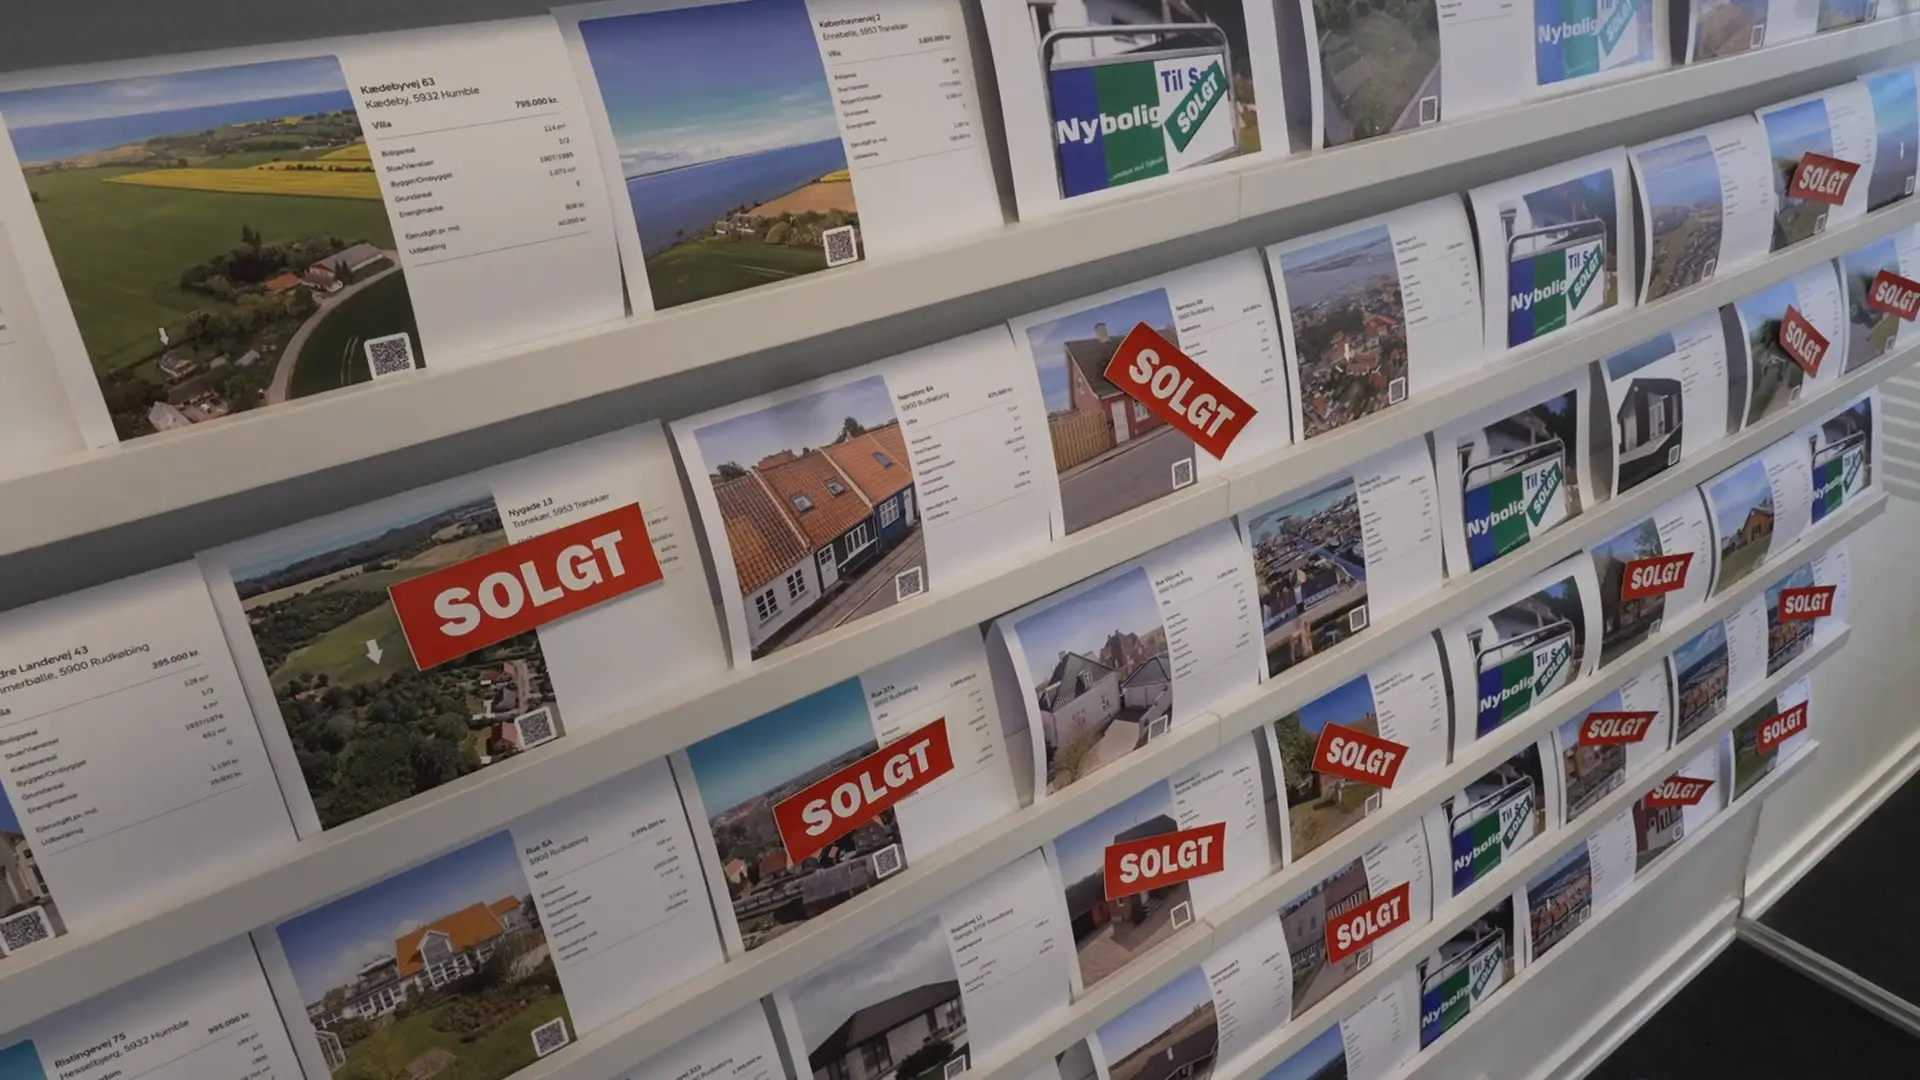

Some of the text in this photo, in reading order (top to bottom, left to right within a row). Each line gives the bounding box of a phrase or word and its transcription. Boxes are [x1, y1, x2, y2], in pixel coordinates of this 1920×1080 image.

[1538, 17, 1599, 44] Nybolig
[360, 78, 435, 94] Kædebyvej 63
[1160, 69, 1184, 92] Til
[365, 87, 480, 109] Kædeby, 5932 Humble
[1176, 72, 1219, 134] SOLGT
[372, 121, 392, 130] Villa
[1056, 103, 1162, 144] Nybolig
[1799, 164, 1850, 196] SOLGT
[1568, 252, 1580, 270] Til
[1573, 252, 1600, 298] SOLGT
[1511, 279, 1567, 312] Nybolig
[1875, 280, 1920, 312] SOLGT
[1785, 320, 1822, 365] SOLGT
[1129, 348, 1236, 438] SOLGT
[1525, 472, 1537, 490] Til
[1533, 470, 1557, 514] SOLGT
[508, 497, 553, 517] Nygade 13
[552, 504, 574, 516] 5953
[1467, 500, 1526, 537] Nybolig
[434, 530, 626, 637] SOLGT
[1631, 560, 1684, 591] SOLGT
[1784, 592, 1830, 613] SOLGT
[19, 650, 72, 673] Landevej
[74, 645, 89, 655] 43
[59, 661, 89, 676] 5900
[90, 644, 150, 667] Rudkøbing
[152, 652, 188, 669] 395.000
[1536, 652, 1548, 667] Til
[1480, 676, 1535, 712] Nybolig
[1587, 717, 1646, 738] SOLGT
[1762, 708, 1803, 744] SOLGT
[1326, 736, 1396, 777] SOLGT
[801, 738, 931, 837] SOLGT
[1652, 781, 1704, 799] SOLGT
[1119, 835, 1213, 884] SOLGT
[1454, 831, 1502, 872] Nybolig
[1336, 895, 1401, 950] SOLGT
[1422, 984, 1472, 1027] Nybolig
[208, 1017, 240, 1034] 995.000
[54, 1032, 126, 1069] Ristingevej 75
[60, 1049, 123, 1080] Hesselbjerg,
[124, 1036, 150, 1052] 5932
[151, 1019, 189, 1040] Humble
